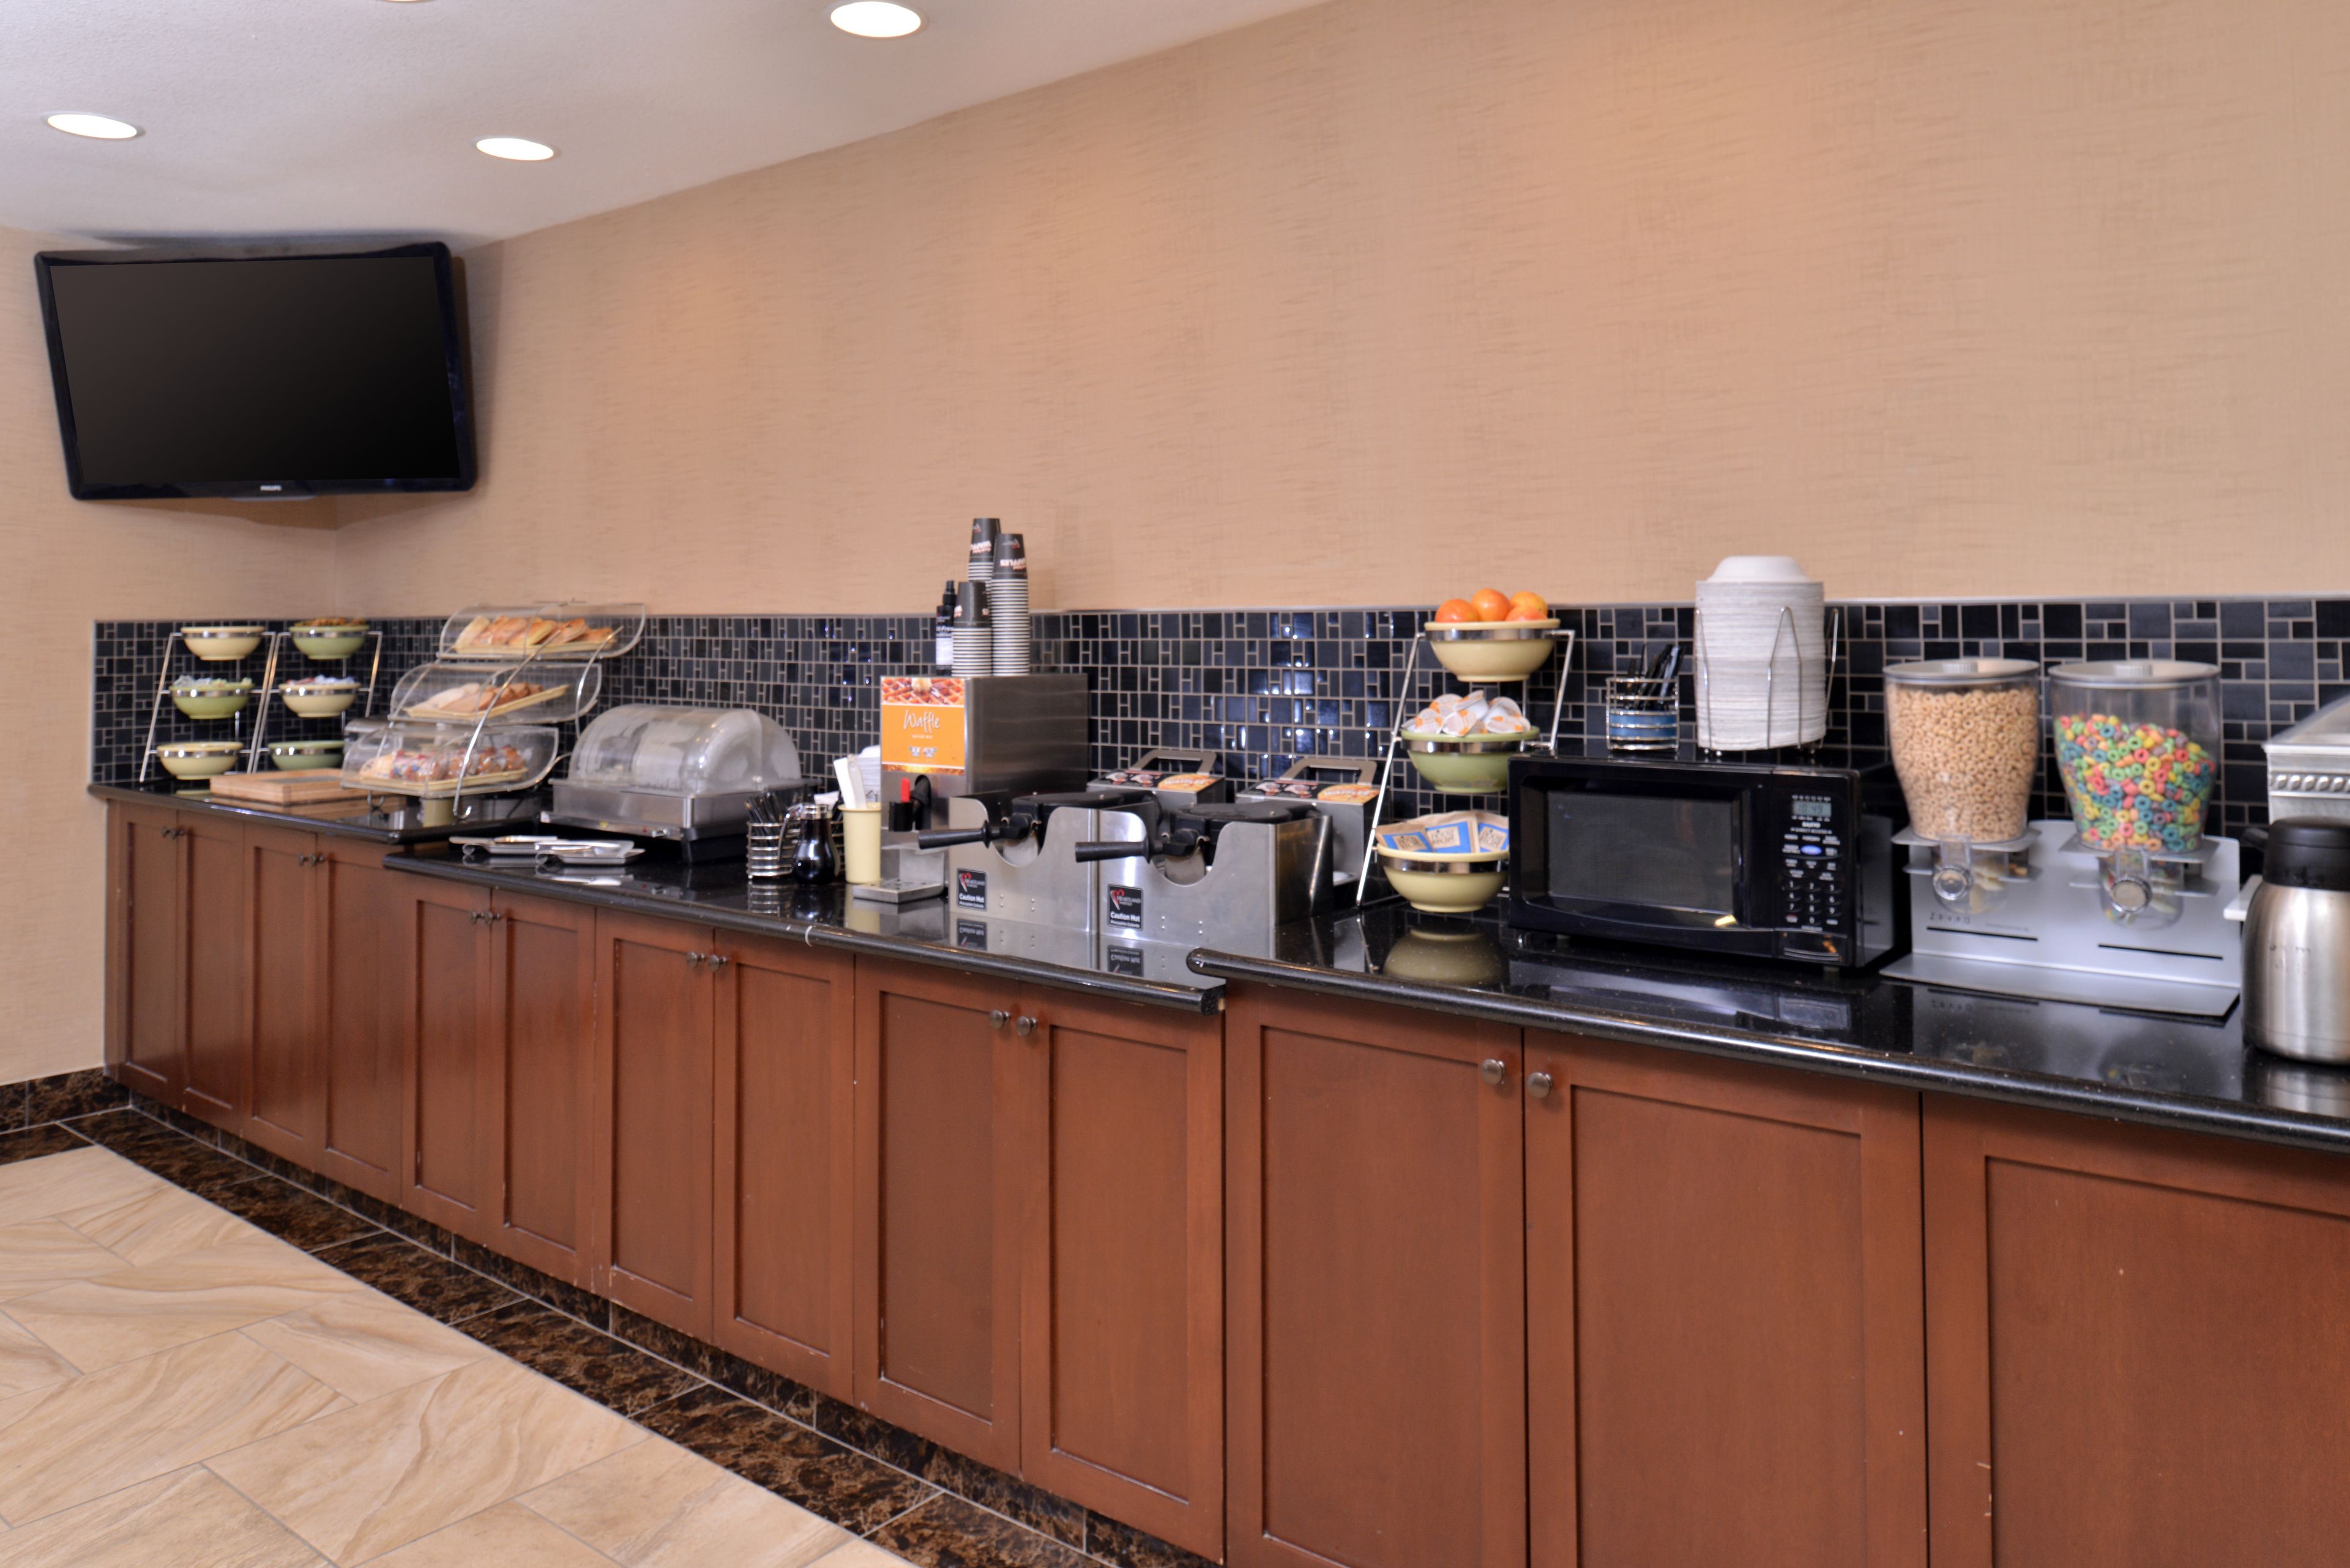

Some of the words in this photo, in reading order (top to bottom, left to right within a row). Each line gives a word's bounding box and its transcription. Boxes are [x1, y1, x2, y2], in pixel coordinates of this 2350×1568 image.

[903, 709, 940, 733] Waffle
[959, 893, 975, 902] Caution
[975, 895, 985, 903] Hot
[1110, 911, 1130, 921] Caution
[1130, 914, 1140, 922] Hot
